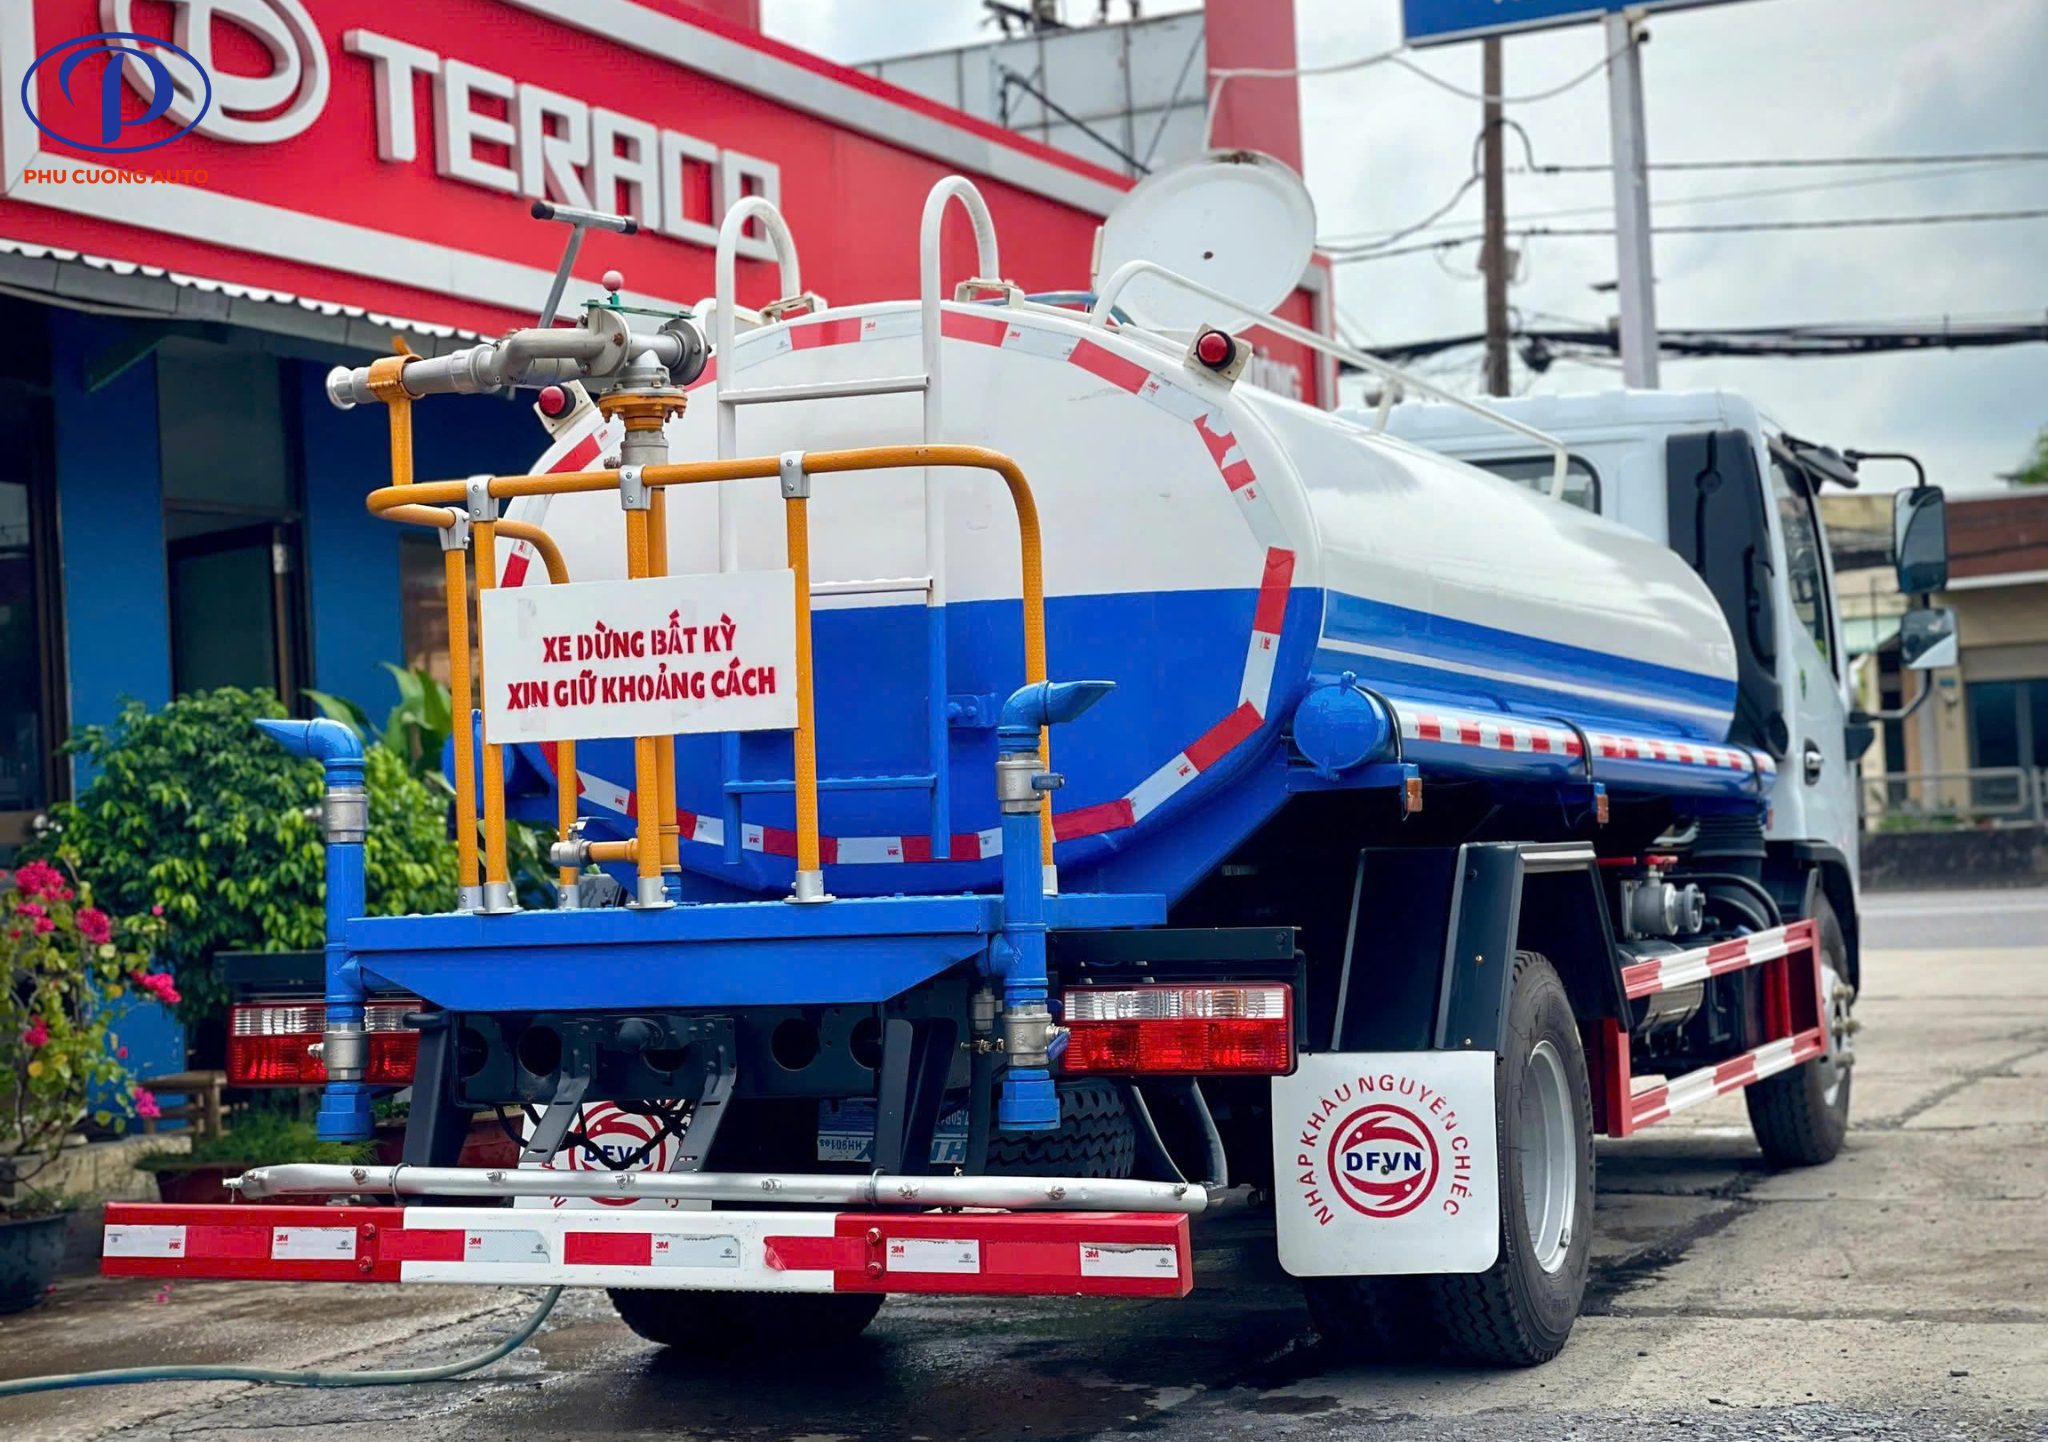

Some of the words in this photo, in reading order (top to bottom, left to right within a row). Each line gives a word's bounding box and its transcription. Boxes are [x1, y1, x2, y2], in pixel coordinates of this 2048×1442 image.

[343, 28, 781, 262] TERACO
[543, 636, 572, 663] XE
[577, 620, 645, 661] DỪNG
[651, 609, 698, 656] BẤT
[704, 612, 737, 653] KỲ
[507, 681, 549, 710] XIN
[554, 669, 597, 707] GIỮ
[602, 662, 706, 704] KHOẢNG
[711, 656, 776, 698] CÁCH
[1346, 1152, 1422, 1171] DFVN
[276, 1234, 288, 1242] 3M
[469, 1237, 481, 1245] 3M
[656, 1241, 669, 1249] 3M
[891, 1245, 904, 1254] 3M
[1085, 1249, 1099, 1259] 3M
